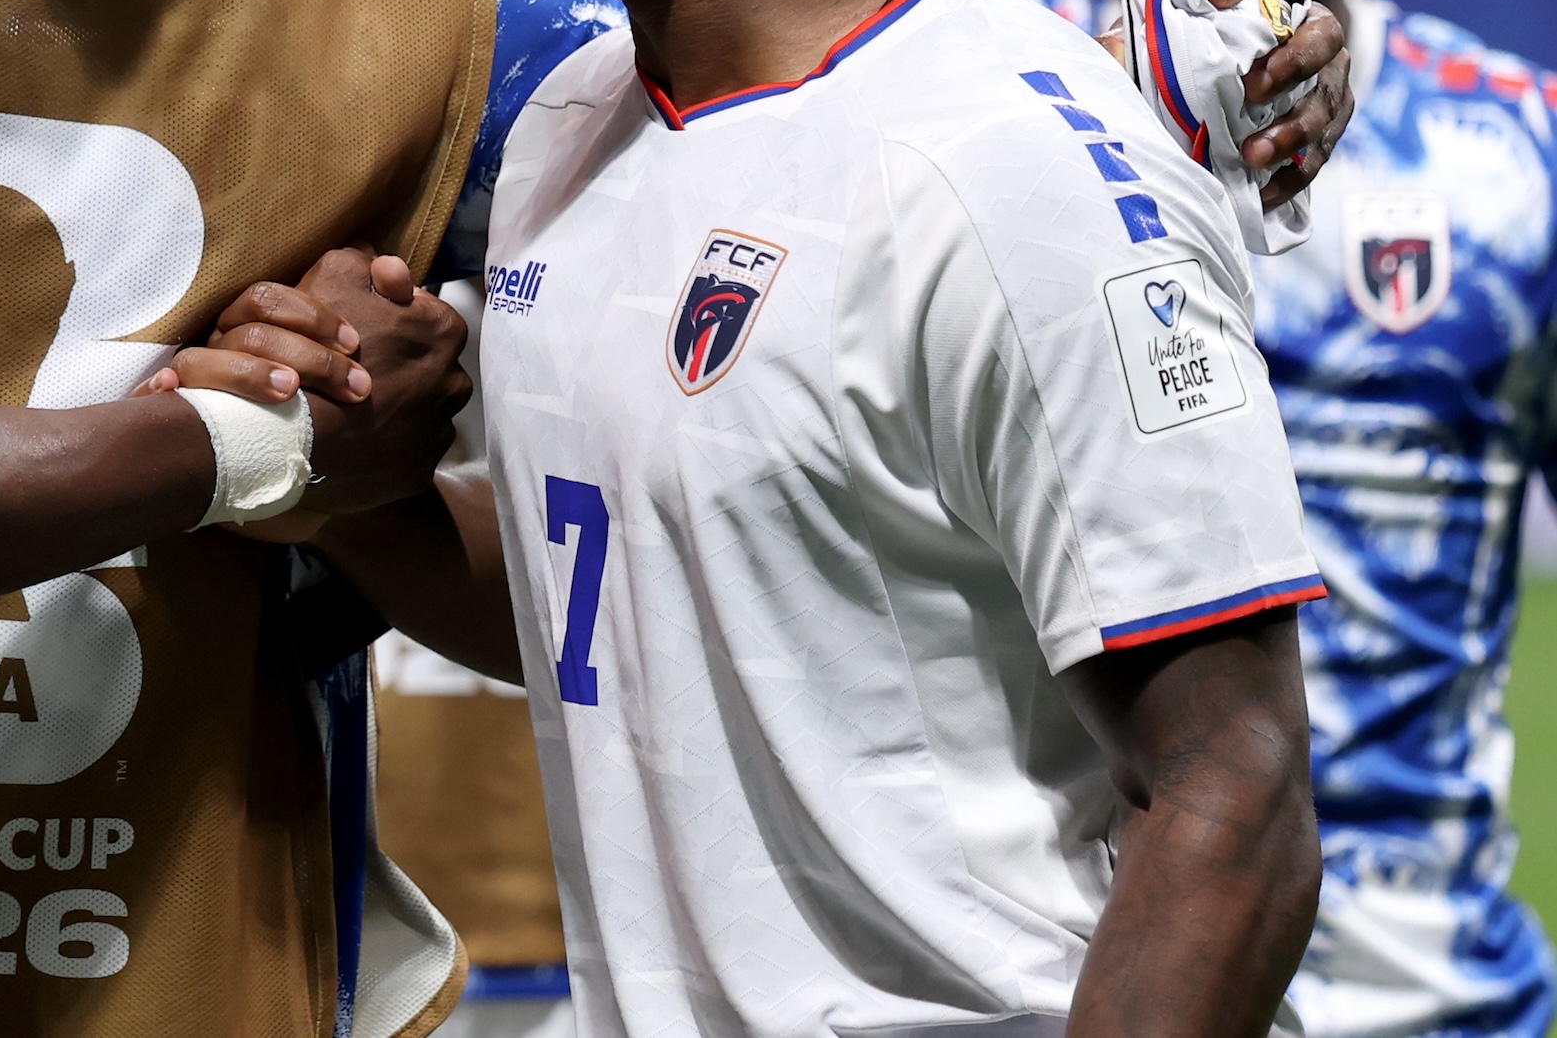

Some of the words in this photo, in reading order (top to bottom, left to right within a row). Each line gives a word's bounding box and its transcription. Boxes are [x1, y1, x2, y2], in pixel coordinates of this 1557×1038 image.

[704, 239, 777, 272] FCF
[492, 297, 534, 317] SPORT
[1147, 334, 1186, 368] Unite
[1158, 357, 1214, 396] PEACE
[1178, 392, 1208, 412] FIFA
[545, 474, 610, 706] 7
